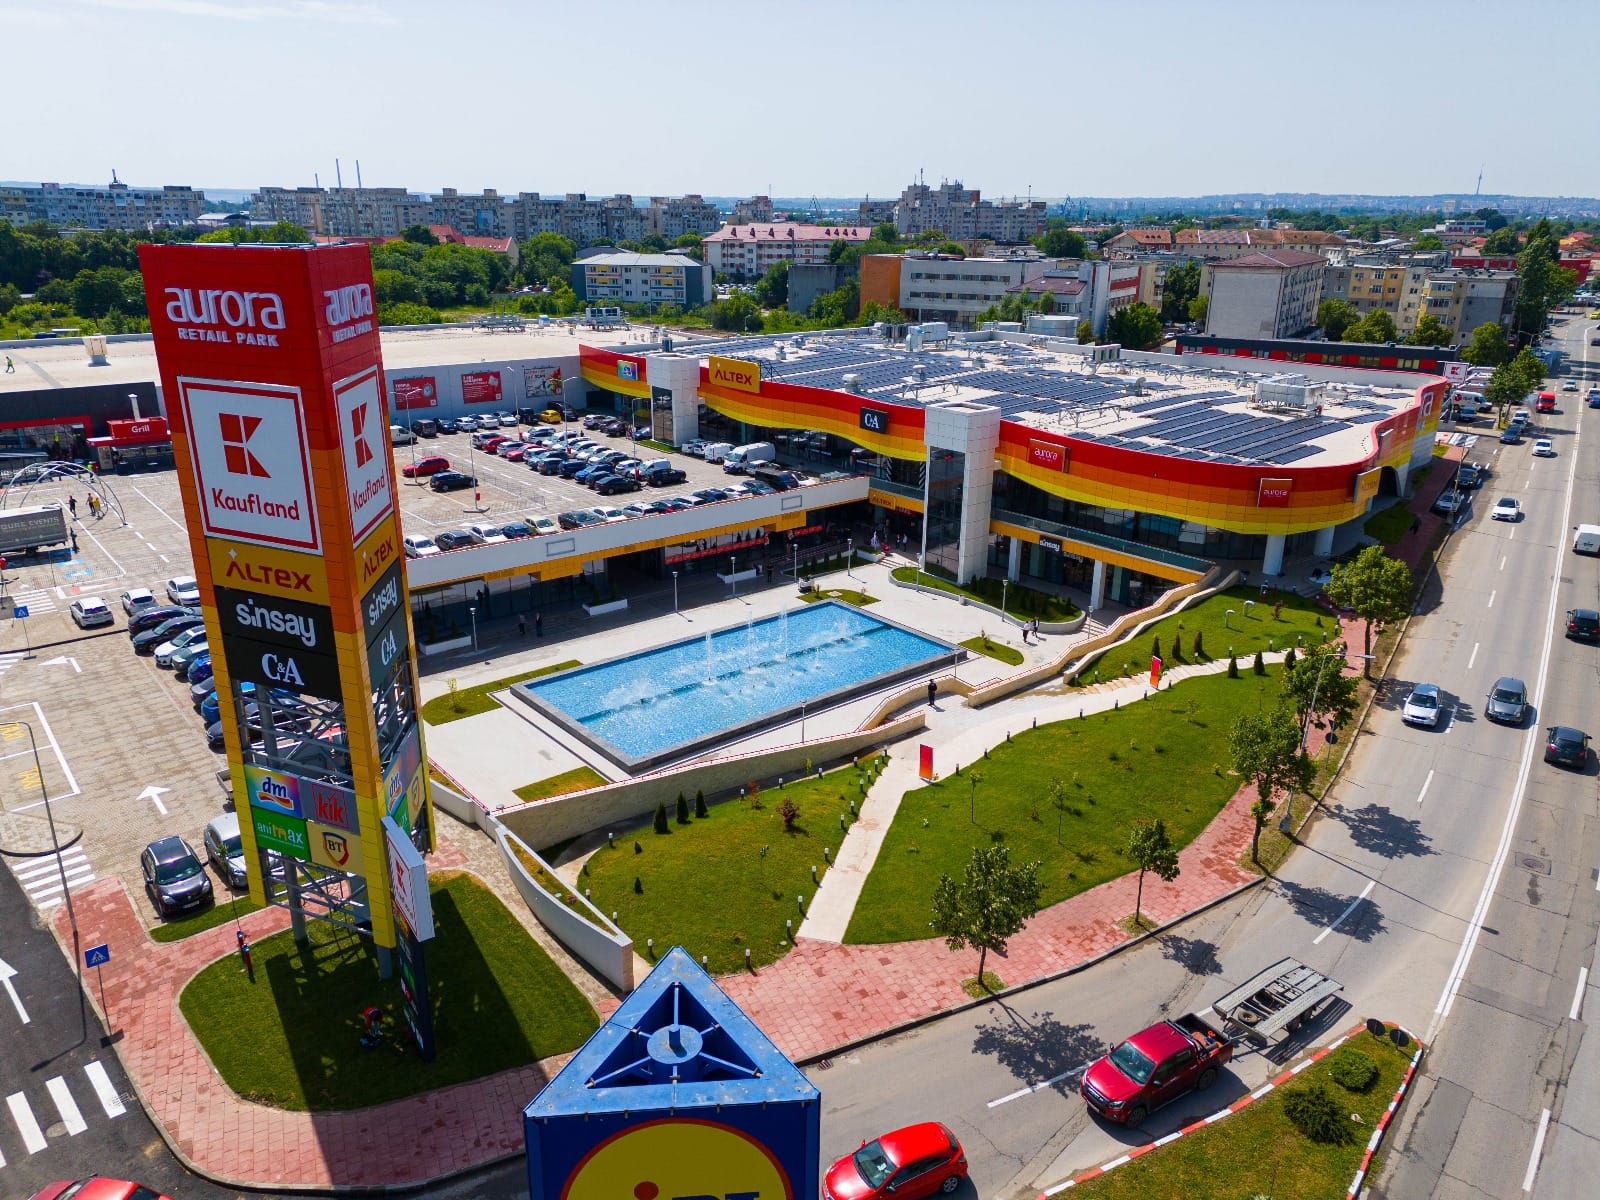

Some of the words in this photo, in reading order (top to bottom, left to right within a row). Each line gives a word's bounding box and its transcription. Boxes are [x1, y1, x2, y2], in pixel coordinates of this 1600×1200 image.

[164, 287, 286, 330] aurora
[323, 283, 373, 326] aurora
[178, 327, 231, 343] RETAIL
[236, 332, 279, 347] PARK
[131, 425, 150, 433] Grill
[1034, 447, 1058, 460] aurora
[212, 487, 300, 521] Kaufland
[352, 471, 385, 512] Kaufland
[369, 576, 397, 626] sinsay
[236, 598, 316, 647] sinsay
[261, 653, 305, 686] C&A
[262, 776, 287, 798] dm
[257, 822, 304, 845] animax
[327, 838, 343, 853] BT
